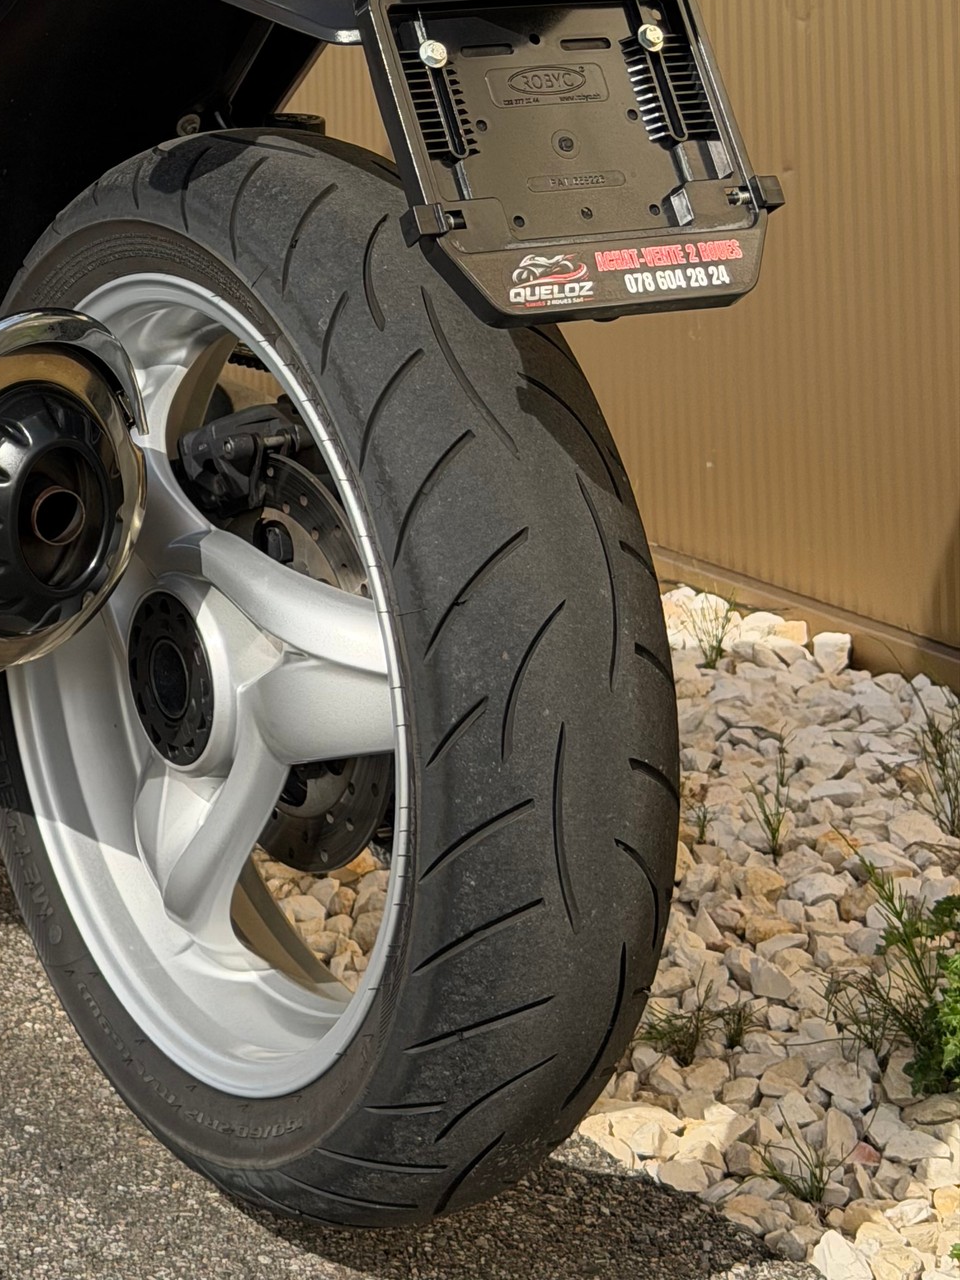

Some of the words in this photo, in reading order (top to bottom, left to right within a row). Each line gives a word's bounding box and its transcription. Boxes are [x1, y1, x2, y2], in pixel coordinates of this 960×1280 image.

[520, 72, 574, 90] ROBYC
[685, 243, 698, 263] 2
[698, 239, 743, 262] ROUES
[624, 271, 656, 294] 078
[655, 269, 687, 291] 604
[687, 267, 708, 287] 28
[708, 265, 730, 285] 24
[509, 281, 594, 303] QUELOZ
